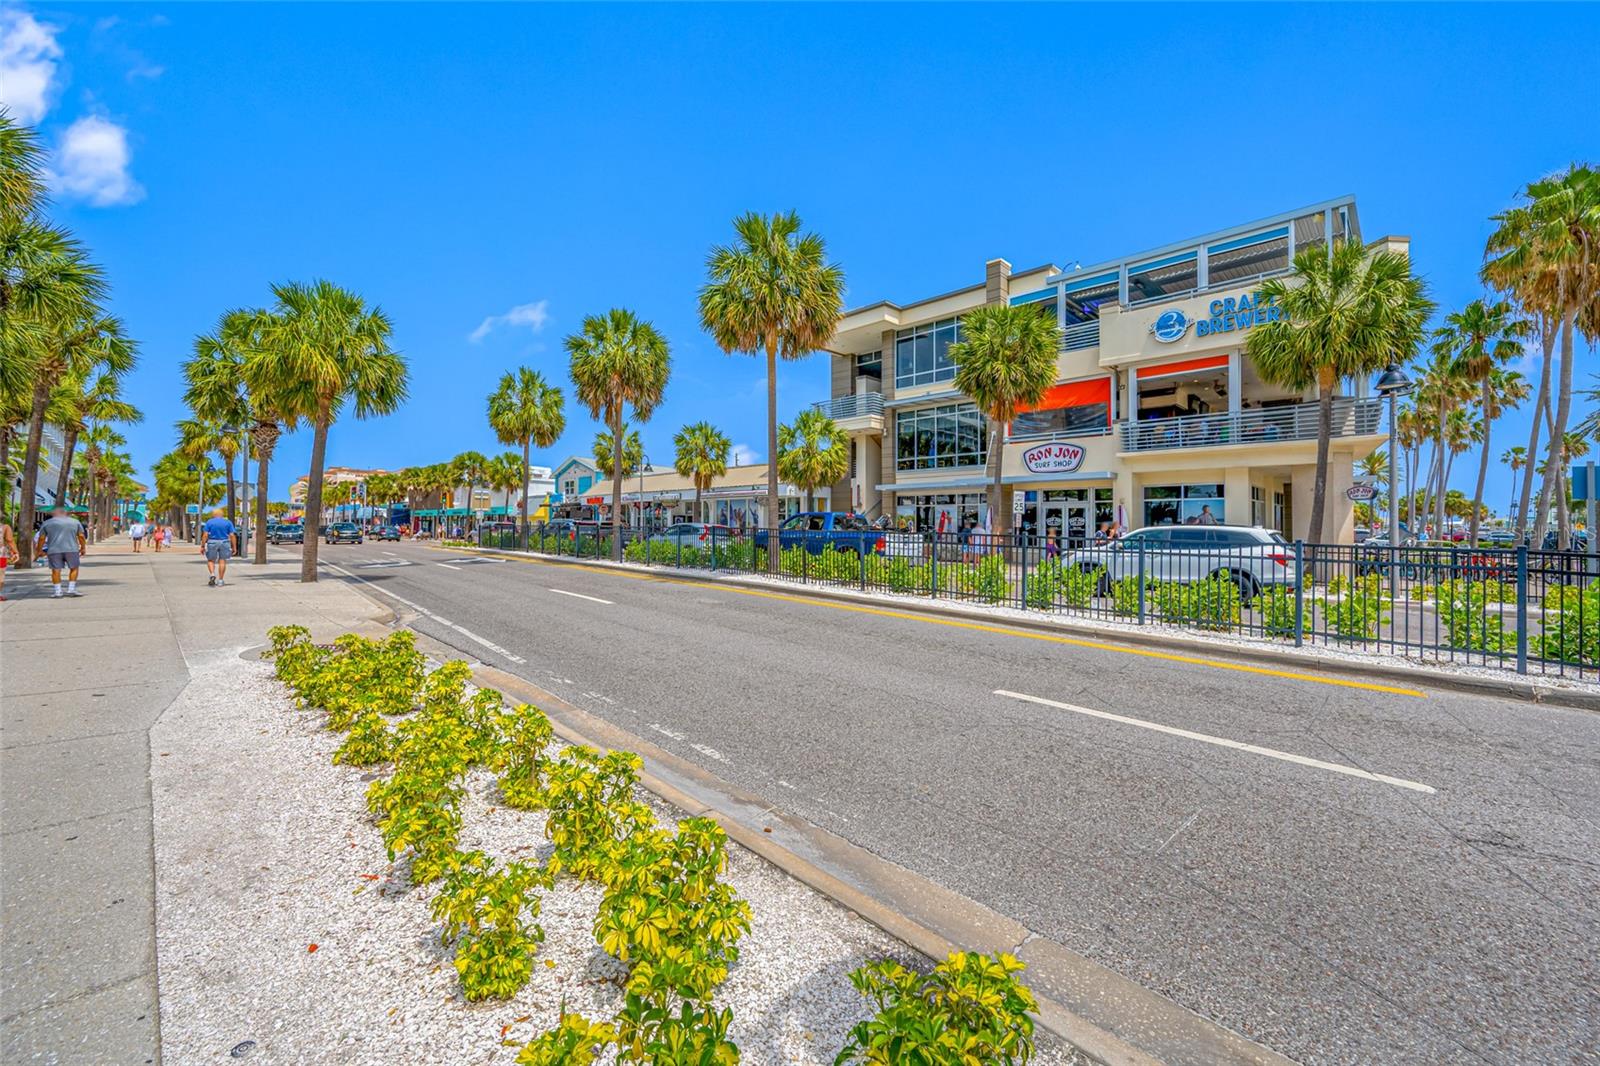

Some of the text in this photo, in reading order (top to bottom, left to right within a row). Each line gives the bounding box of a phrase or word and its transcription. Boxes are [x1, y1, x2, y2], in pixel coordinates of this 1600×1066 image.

[1028, 447, 1080, 464] RON JON
[1034, 460, 1073, 469] SURF SHOP
[1014, 502, 1024, 511] 25
